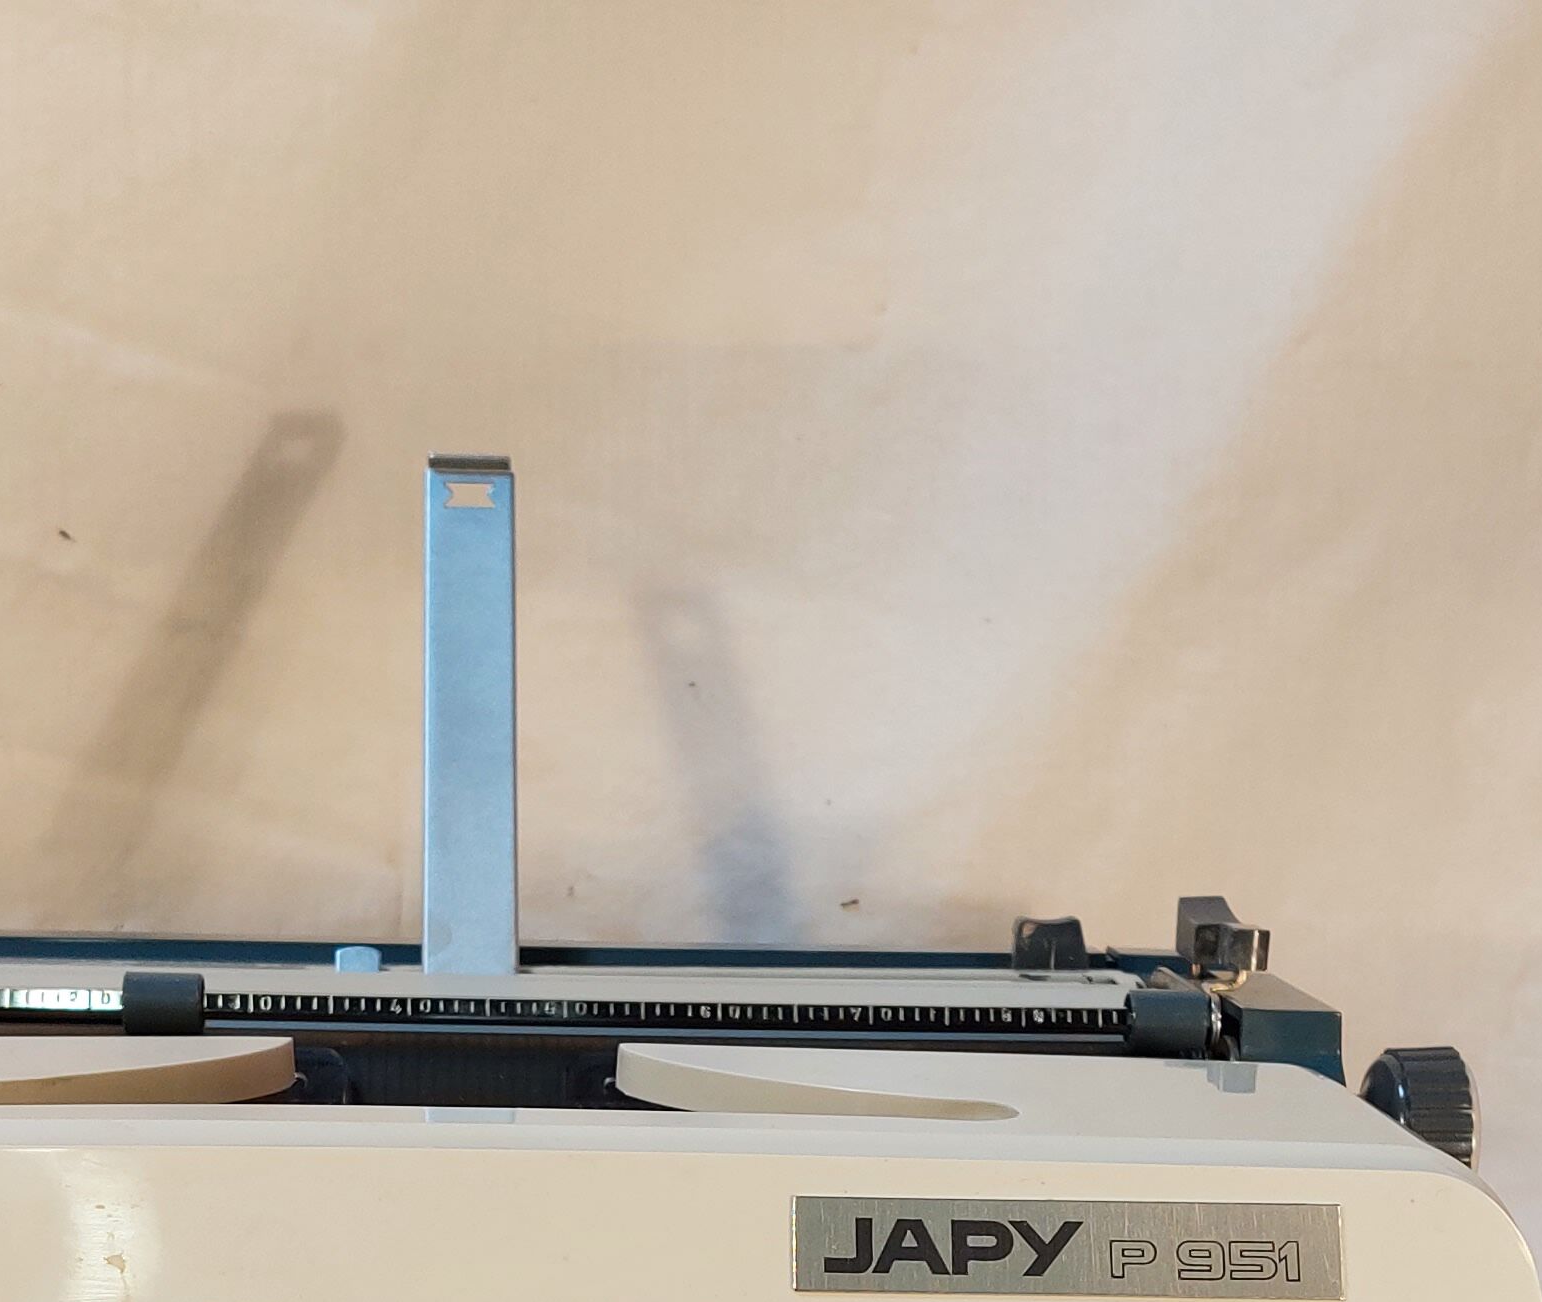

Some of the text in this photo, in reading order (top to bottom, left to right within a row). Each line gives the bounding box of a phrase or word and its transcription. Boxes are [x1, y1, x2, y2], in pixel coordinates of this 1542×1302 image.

[823, 1216, 1301, 1283] JAPY P 951
